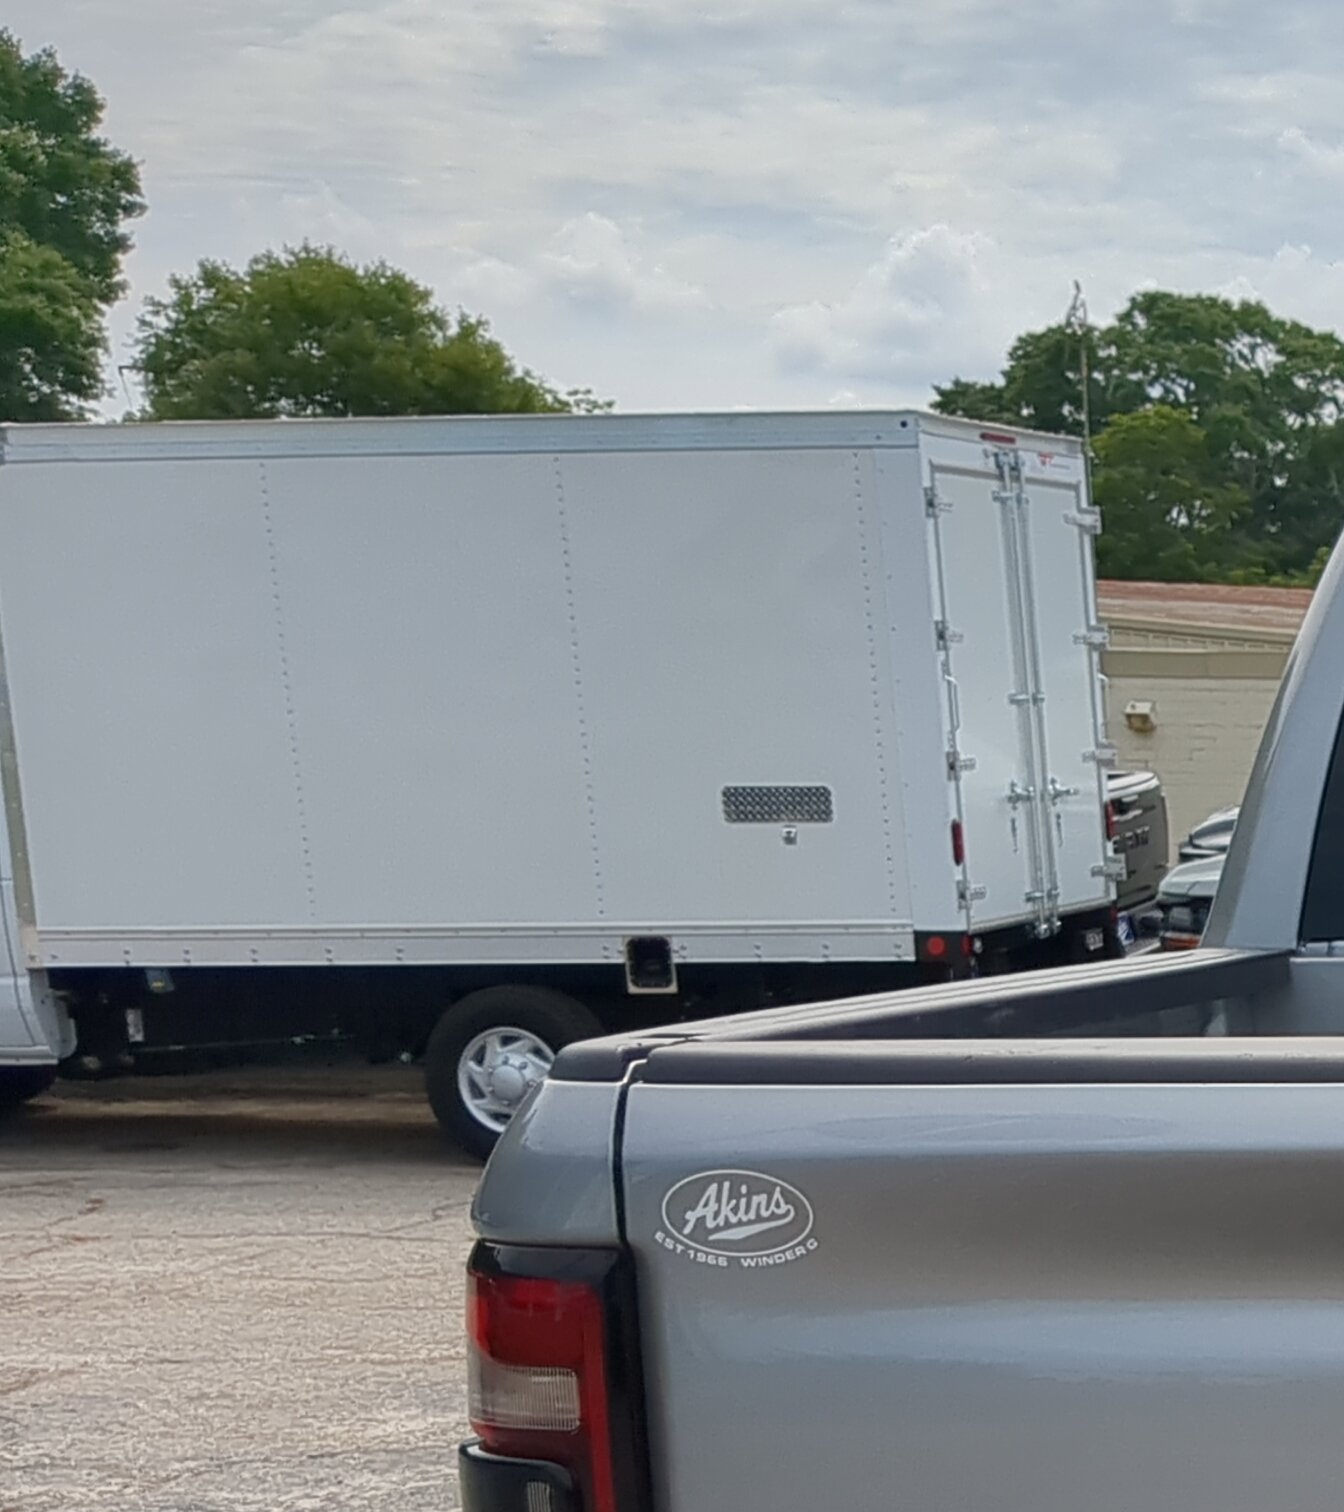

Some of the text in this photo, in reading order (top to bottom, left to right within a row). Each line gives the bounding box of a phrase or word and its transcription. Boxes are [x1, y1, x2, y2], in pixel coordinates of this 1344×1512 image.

[682, 1180, 795, 1240] Akins
[654, 1230, 686, 1255] EST
[687, 1248, 728, 1268] 1966
[740, 1245, 807, 1269] WINDER
